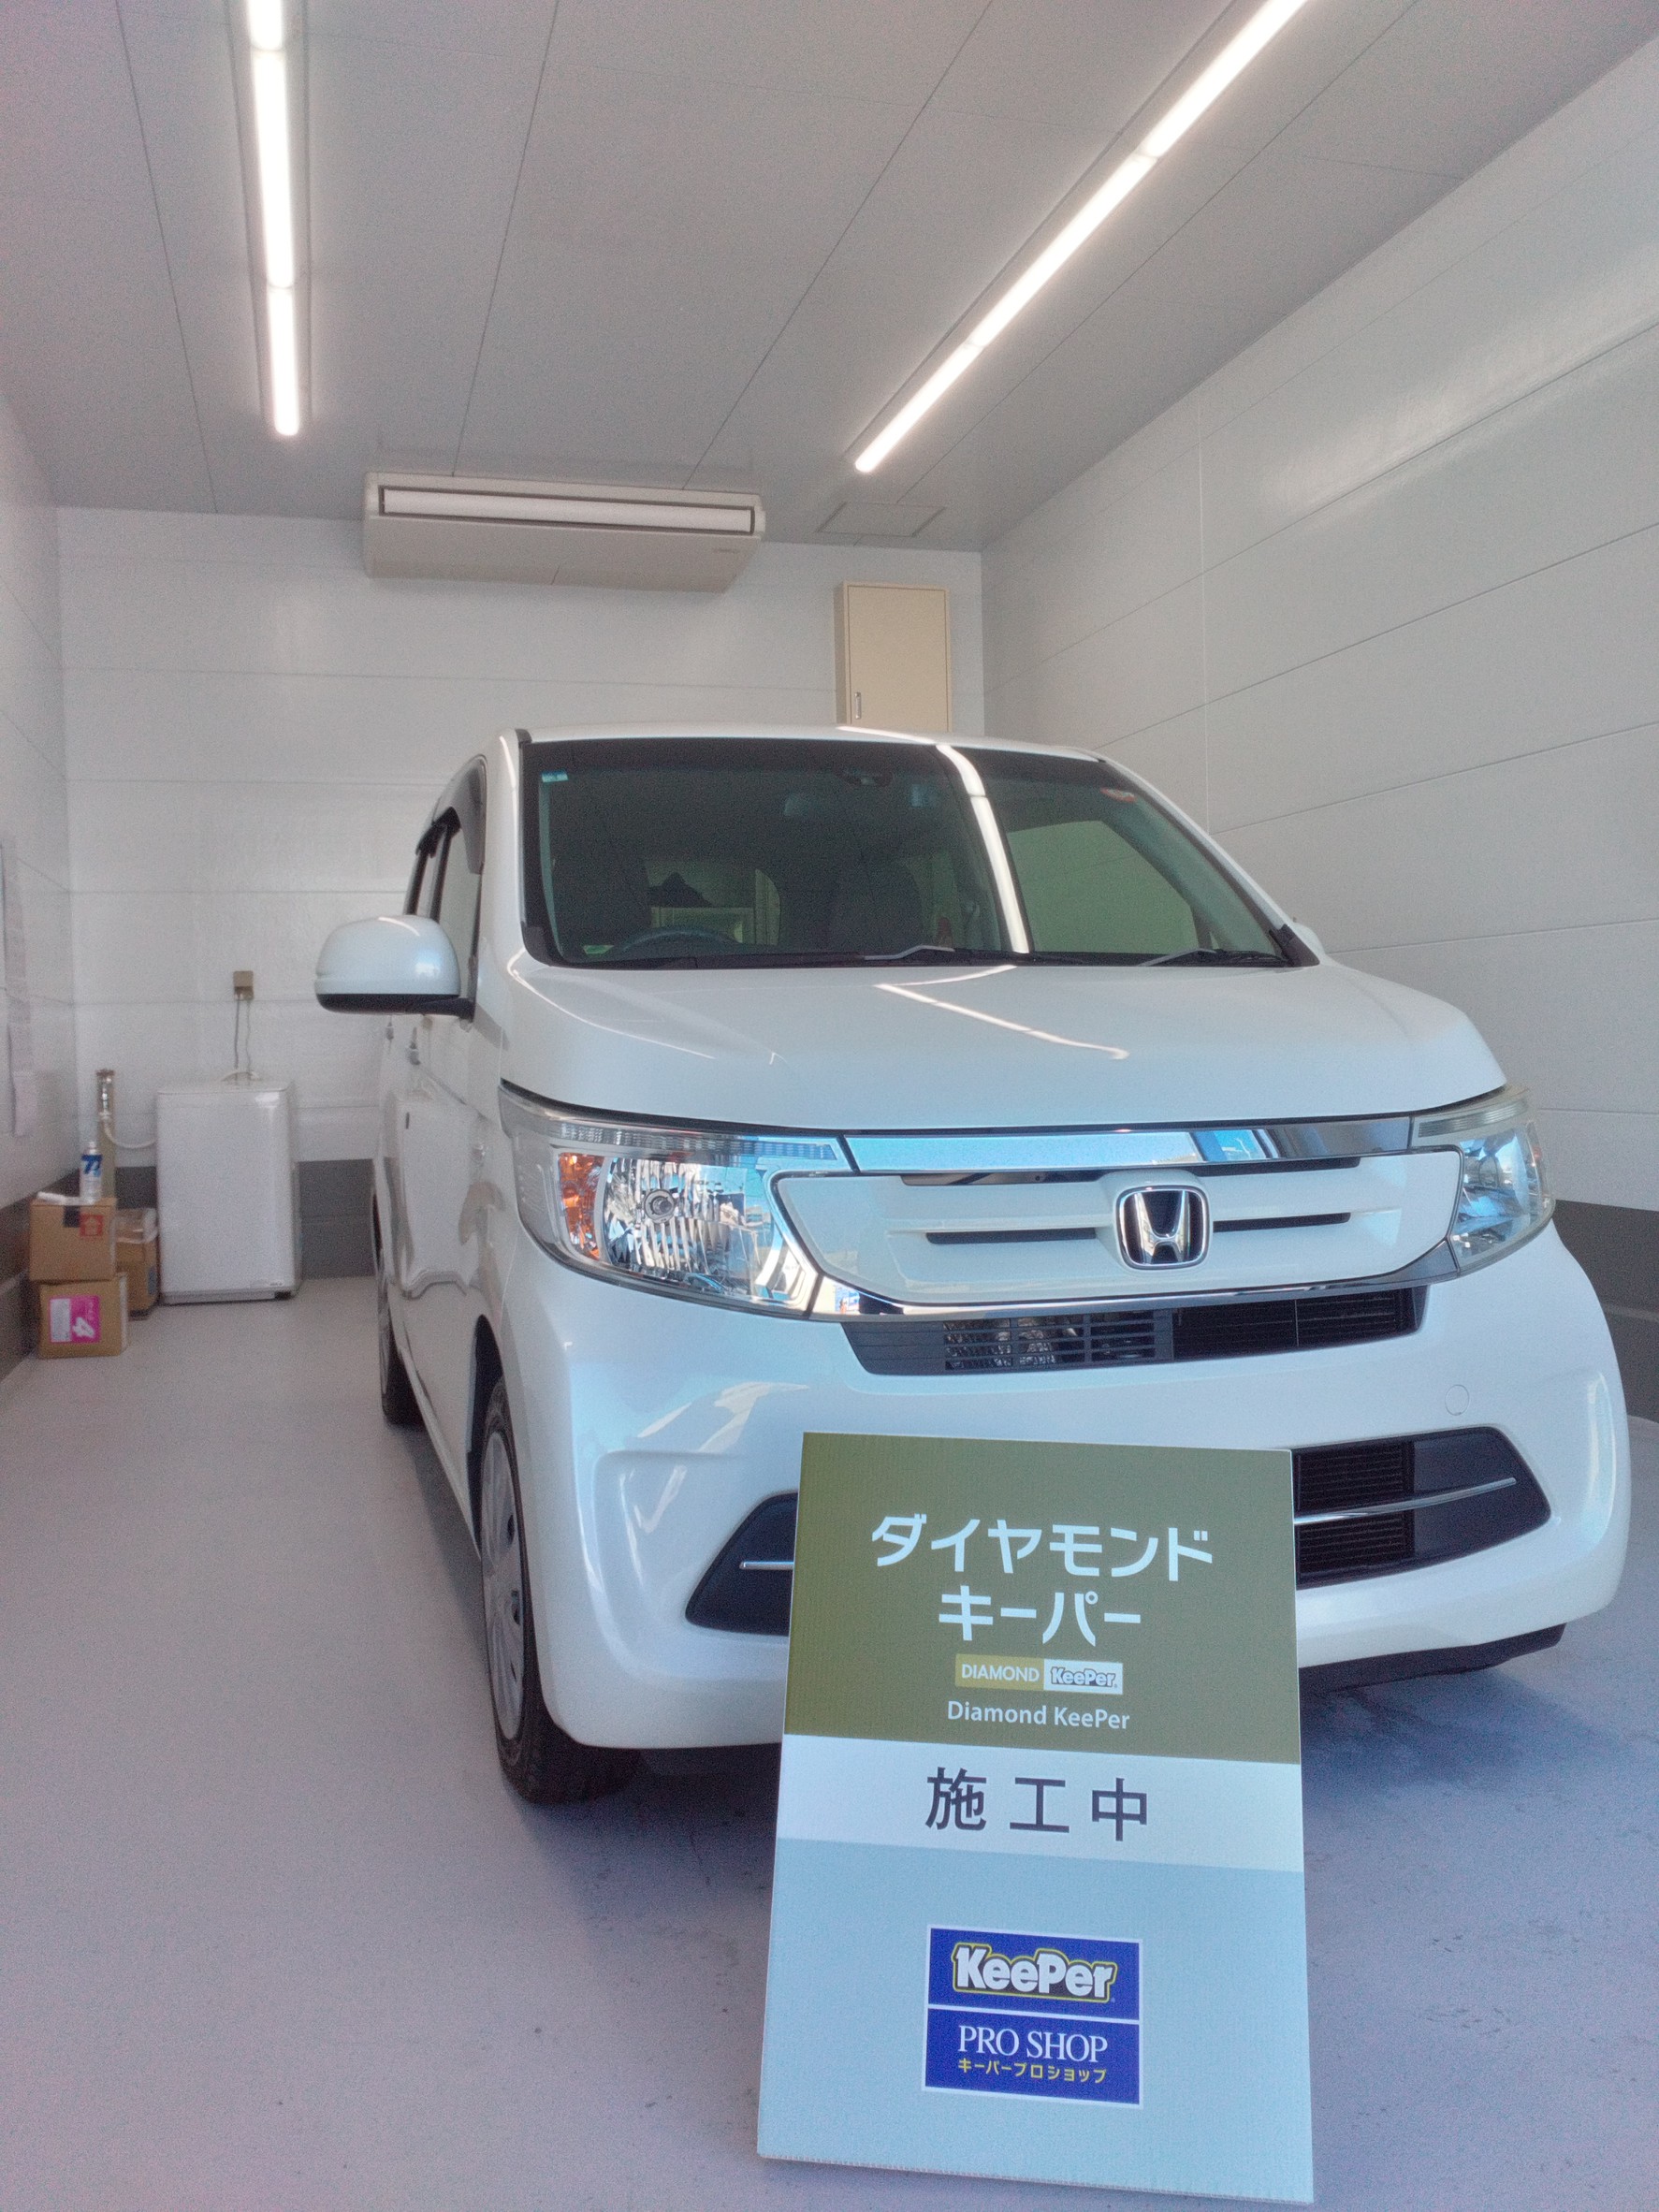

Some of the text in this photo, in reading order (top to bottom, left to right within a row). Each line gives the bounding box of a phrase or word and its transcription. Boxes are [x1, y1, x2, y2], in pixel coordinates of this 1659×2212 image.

[871, 1512, 1213, 1582] ダイヤモンド
[939, 1584, 1142, 1648] キーパー
[960, 1663, 1116, 1687] DIAMOND KeePer
[947, 1700, 1130, 1729] Diamond KeePer
[924, 1766, 1148, 1841] 施工中
[953, 1943, 1116, 2001] KeePer
[957, 2025, 1109, 2063] PRO SHOP
